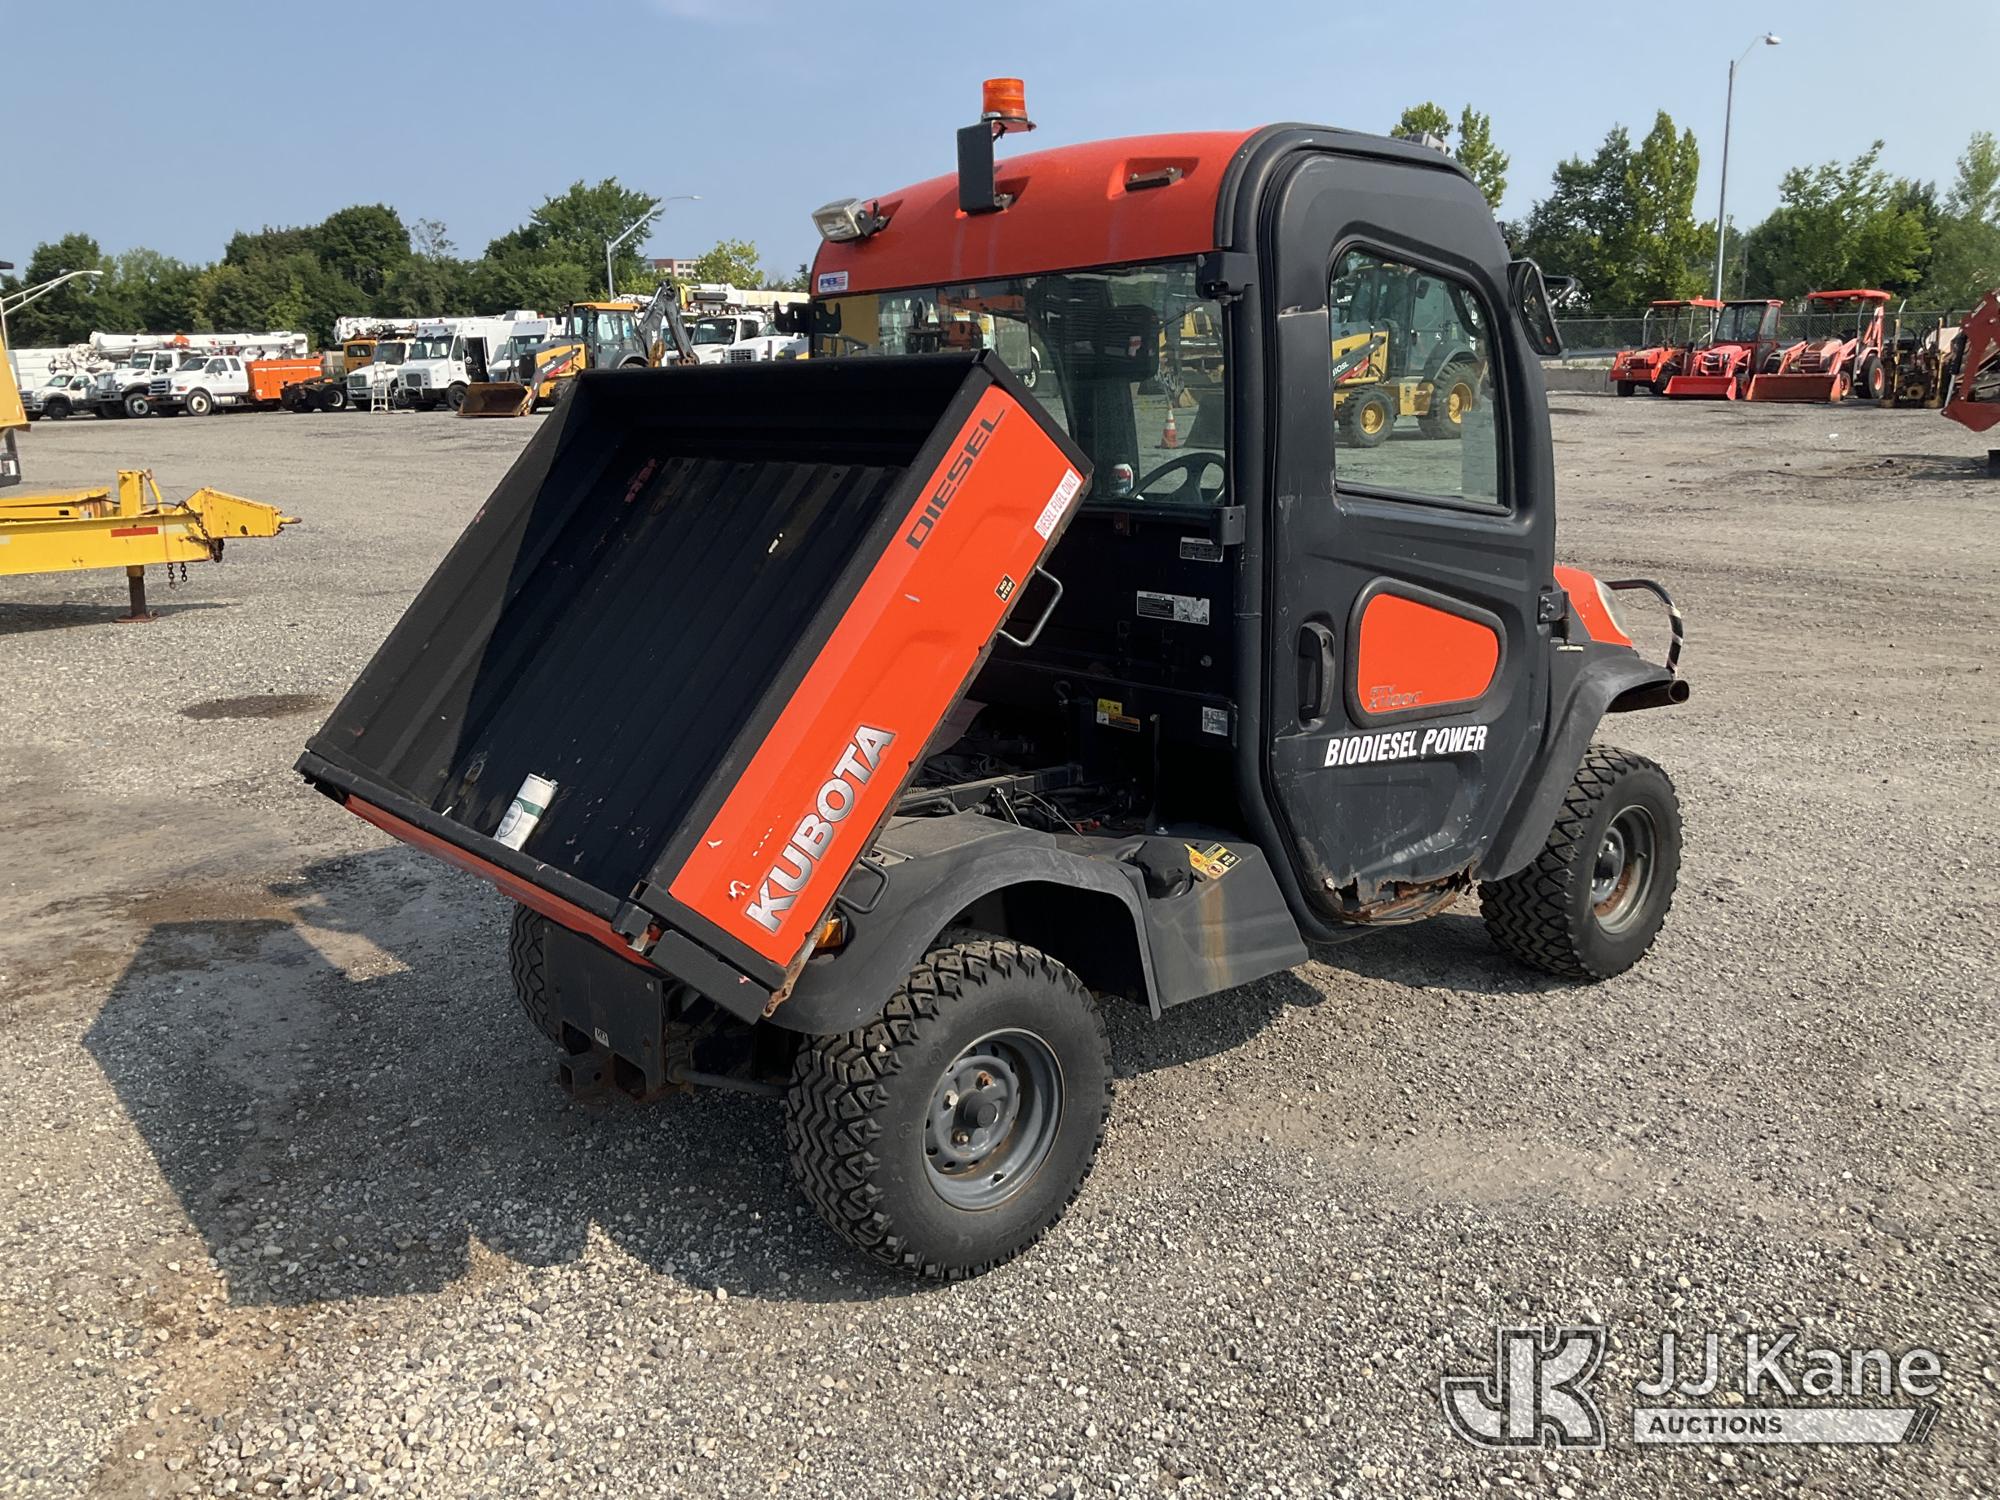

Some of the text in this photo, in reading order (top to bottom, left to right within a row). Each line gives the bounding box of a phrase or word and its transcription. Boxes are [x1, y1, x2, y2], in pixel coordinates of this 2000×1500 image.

[906, 409, 1005, 550] DIESEL
[1037, 472, 1078, 536] DIESEL FUEL ONLY
[999, 580, 1008, 592] NO
[1001, 581, 1013, 599] STEP
[1323, 725, 1489, 767] BIODIESEL POWER
[743, 724, 896, 933] KUBOTA
